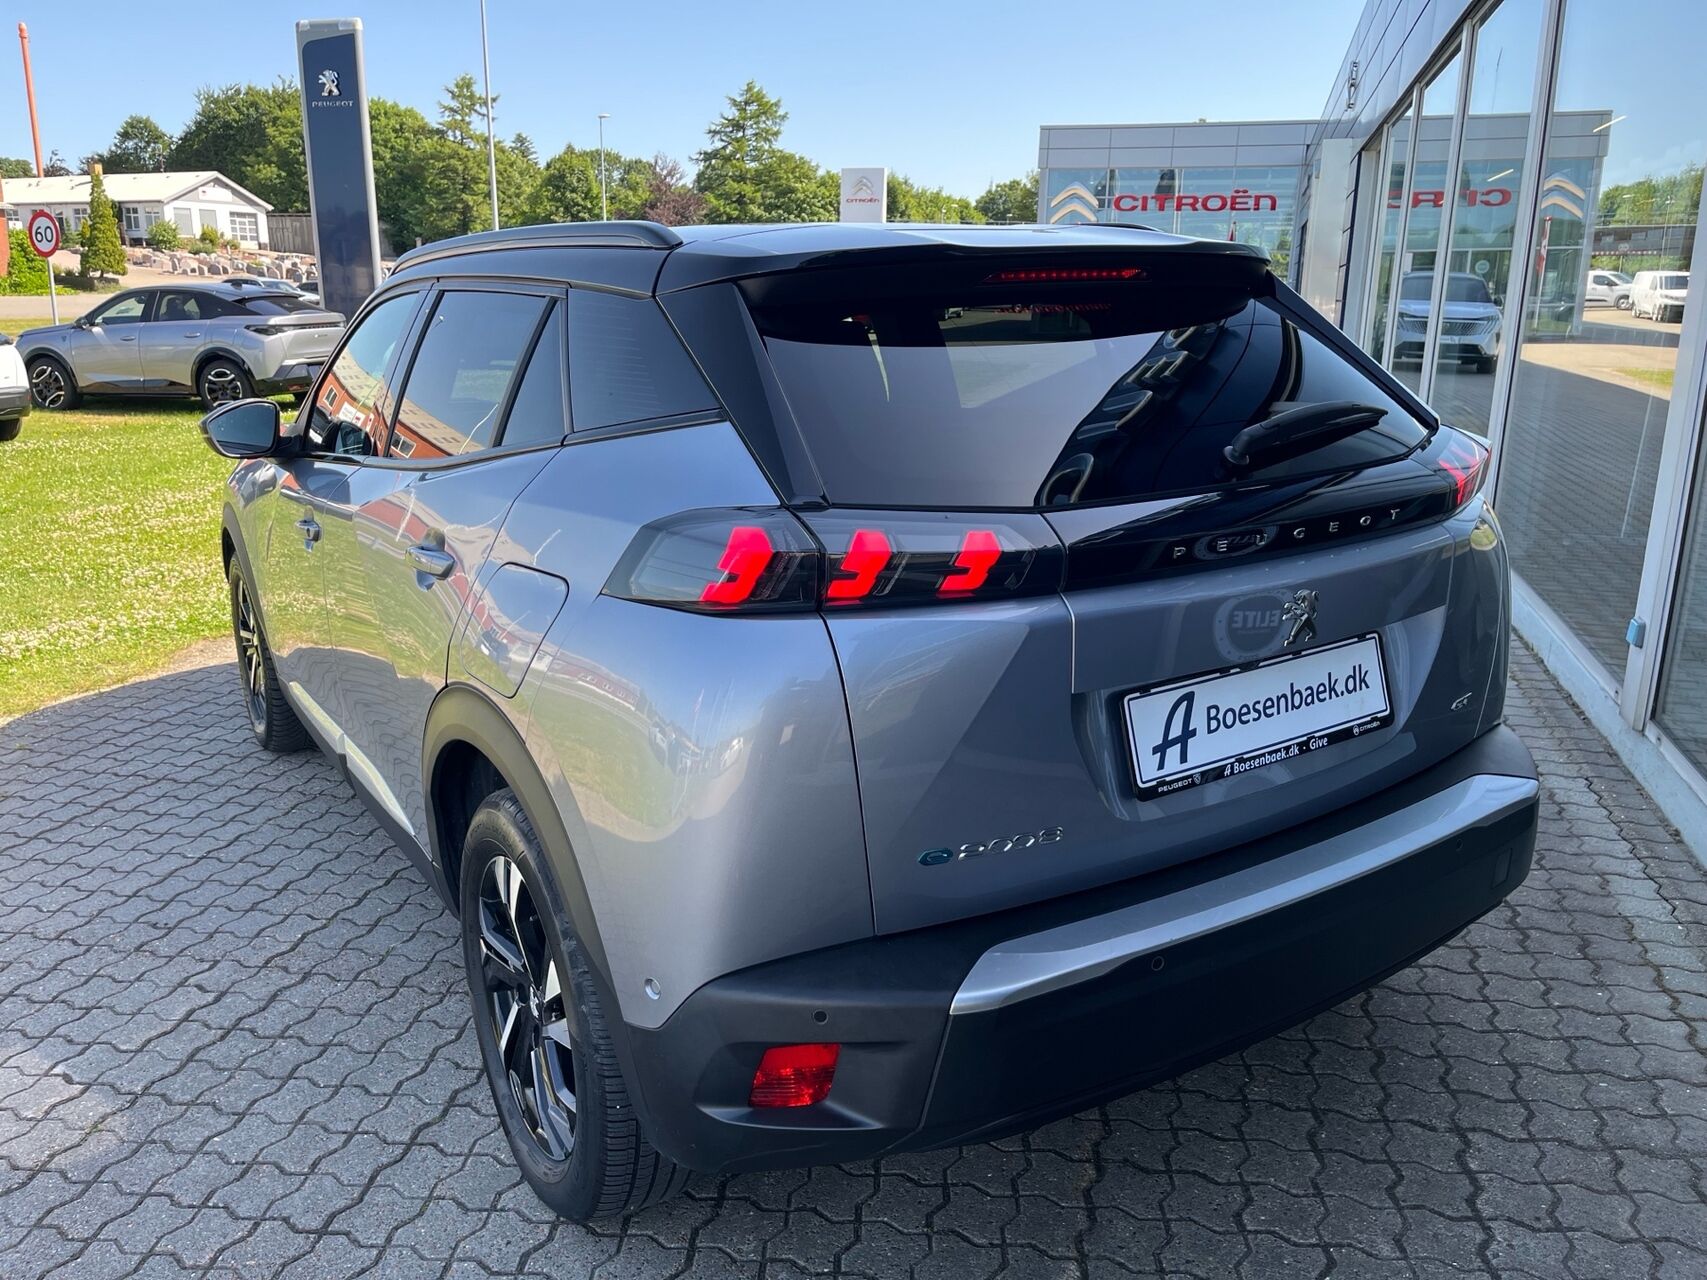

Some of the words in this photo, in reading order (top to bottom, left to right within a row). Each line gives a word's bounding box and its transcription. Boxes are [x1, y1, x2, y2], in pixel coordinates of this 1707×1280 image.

[312, 100, 354, 108] PEUGEOT
[34, 225, 54, 243] 60
[1173, 508, 1401, 560] PEUGEOT
[1206, 663, 1371, 735] Boesenbaek.dk
[1233, 744, 1300, 774] Boesenbaek.dk
[1309, 736, 1328, 751] Give
[1157, 778, 1193, 793] PEUGEOT
